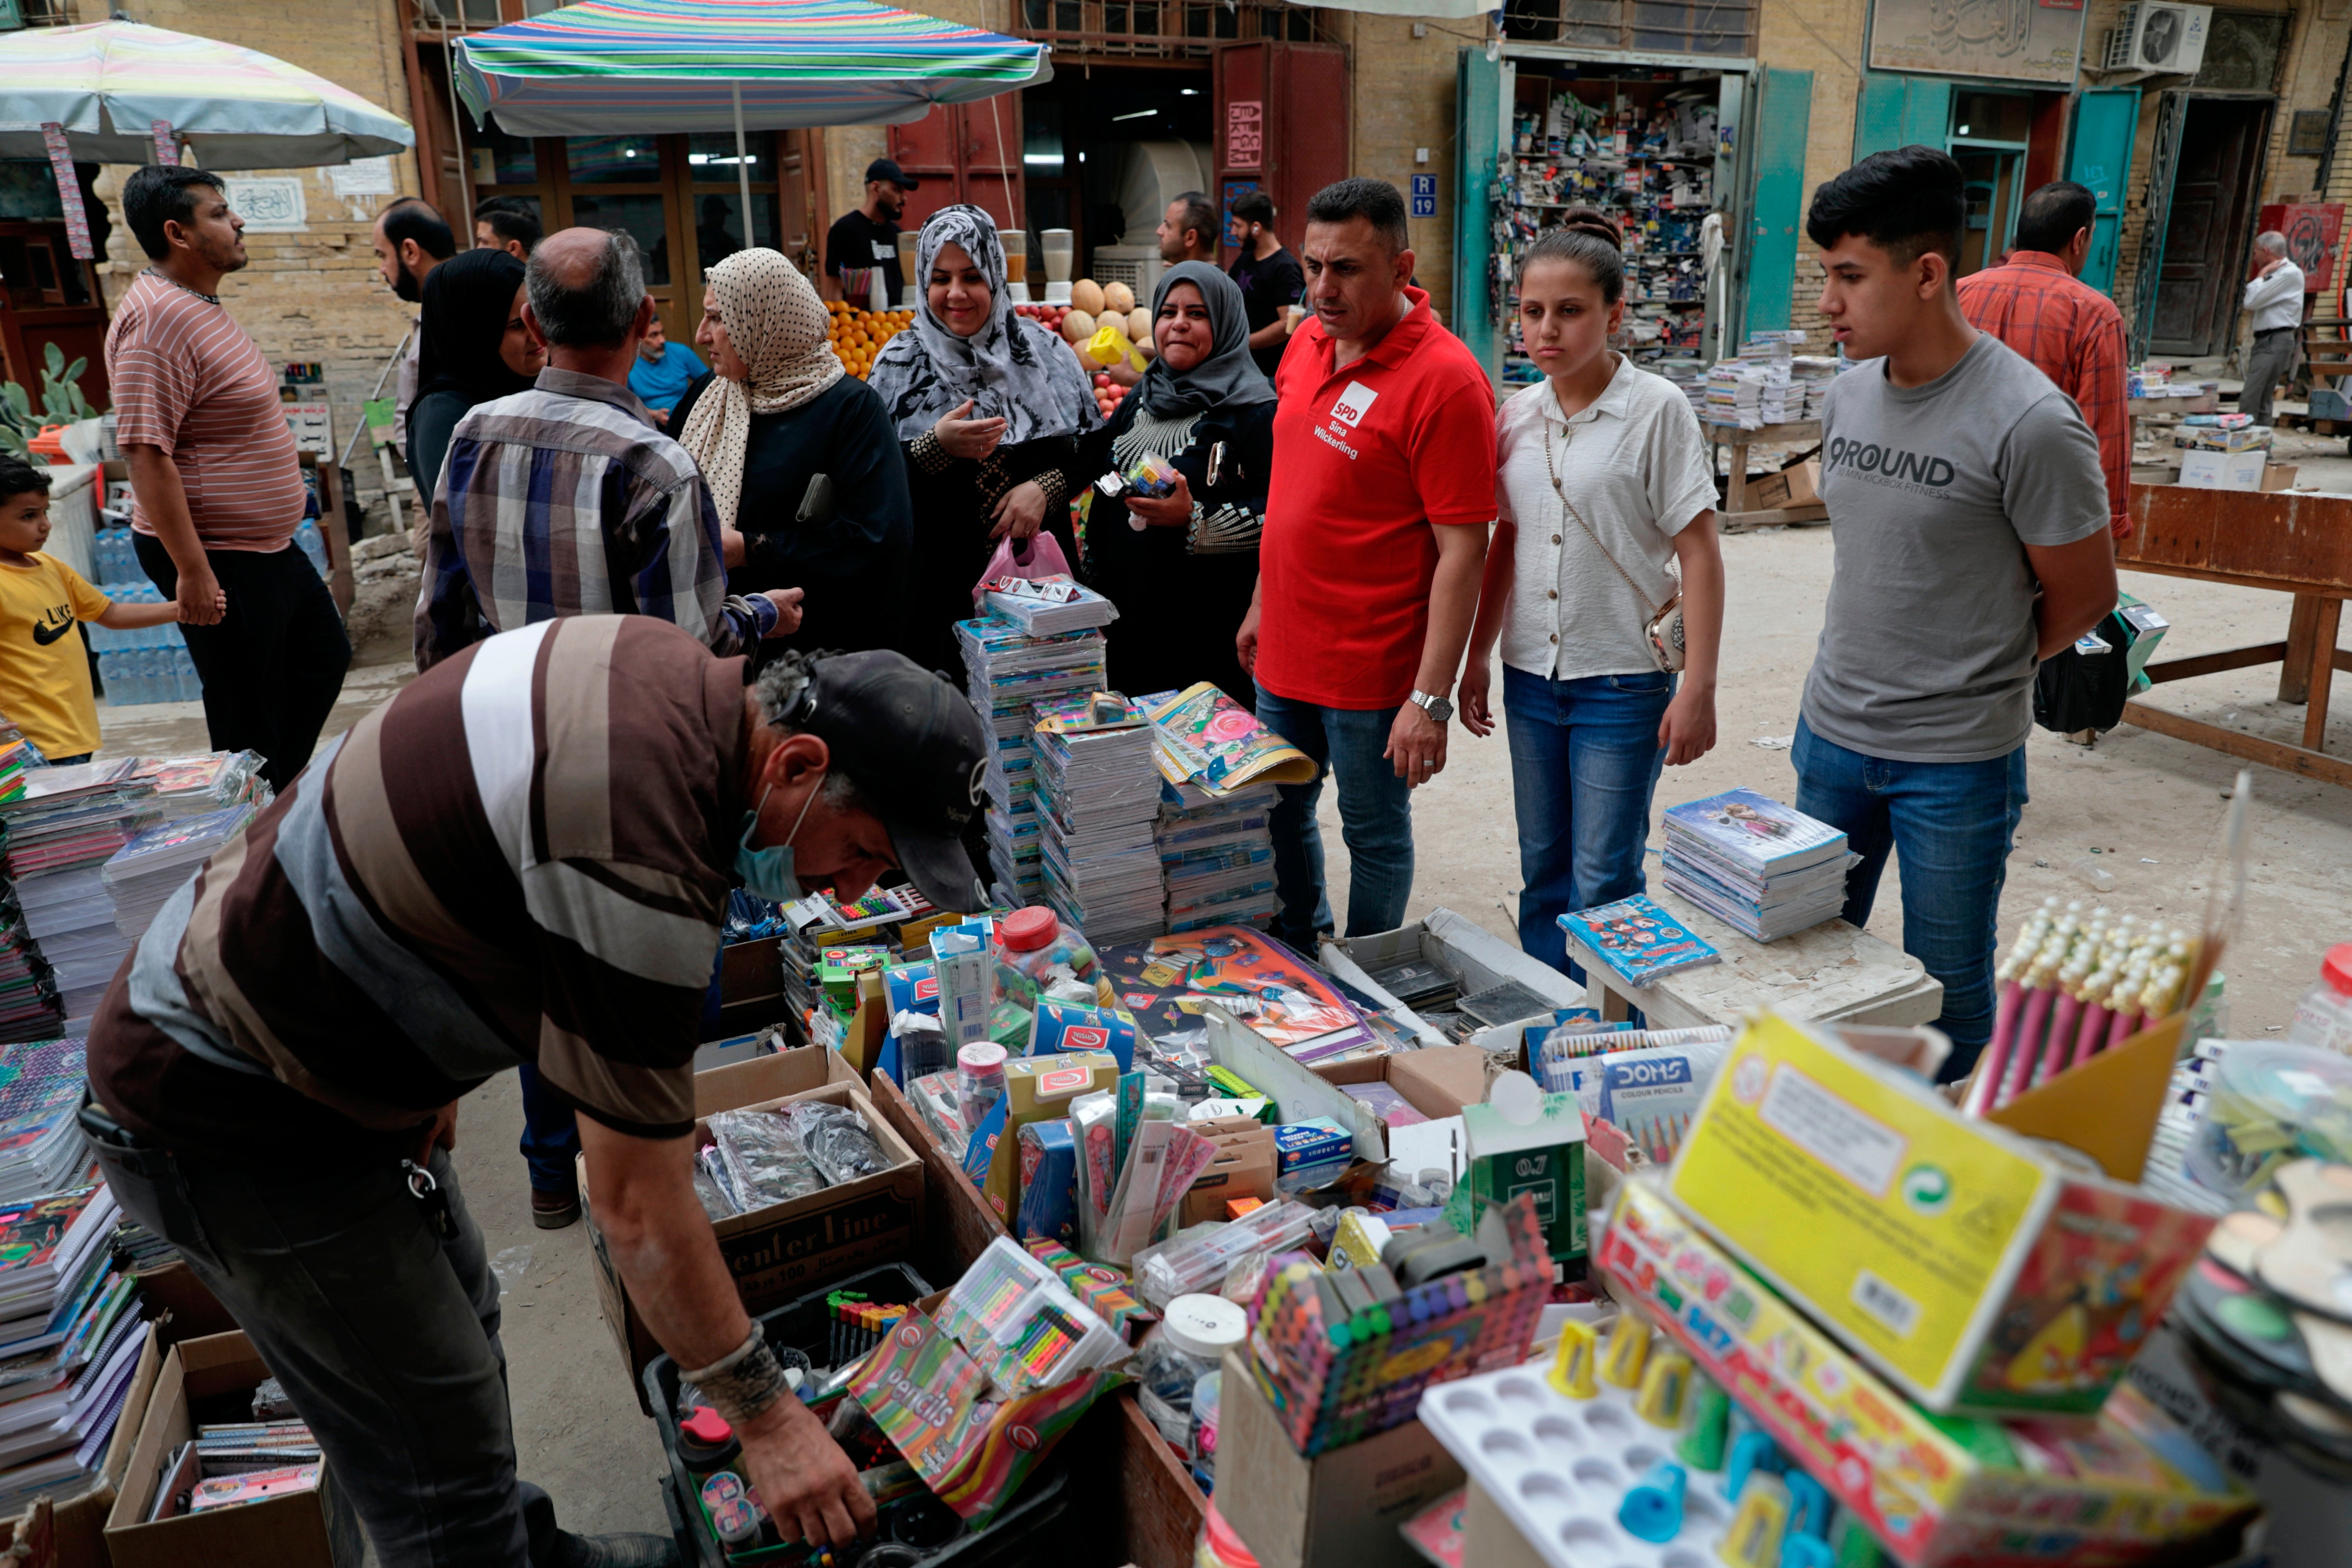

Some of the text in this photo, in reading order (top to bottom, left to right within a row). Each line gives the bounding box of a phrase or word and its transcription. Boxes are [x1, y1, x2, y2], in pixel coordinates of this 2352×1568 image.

[1419, 176, 1429, 193] R
[1416, 199, 1432, 213] 19
[1335, 402, 1358, 421] SPD
[1329, 420, 1347, 437] Sina
[1314, 425, 1358, 460] Wilckerling
[1827, 436, 1955, 487] 9ROUND
[1836, 467, 1951, 500] 30 MIN KICKBOX FITNESS
[46, 603, 74, 625] LIKE
[1072, 1031, 1096, 1041] CRYSTAL
[1048, 1073, 1075, 1084] CRYSTAL
[1617, 1061, 1682, 1084] DOMS
[1653, 1087, 1683, 1095] PENCILS
[1516, 1155, 1547, 1177] 0.7
[778, 1264, 805, 1283] 100
[878, 1366, 955, 1430] Pencils
